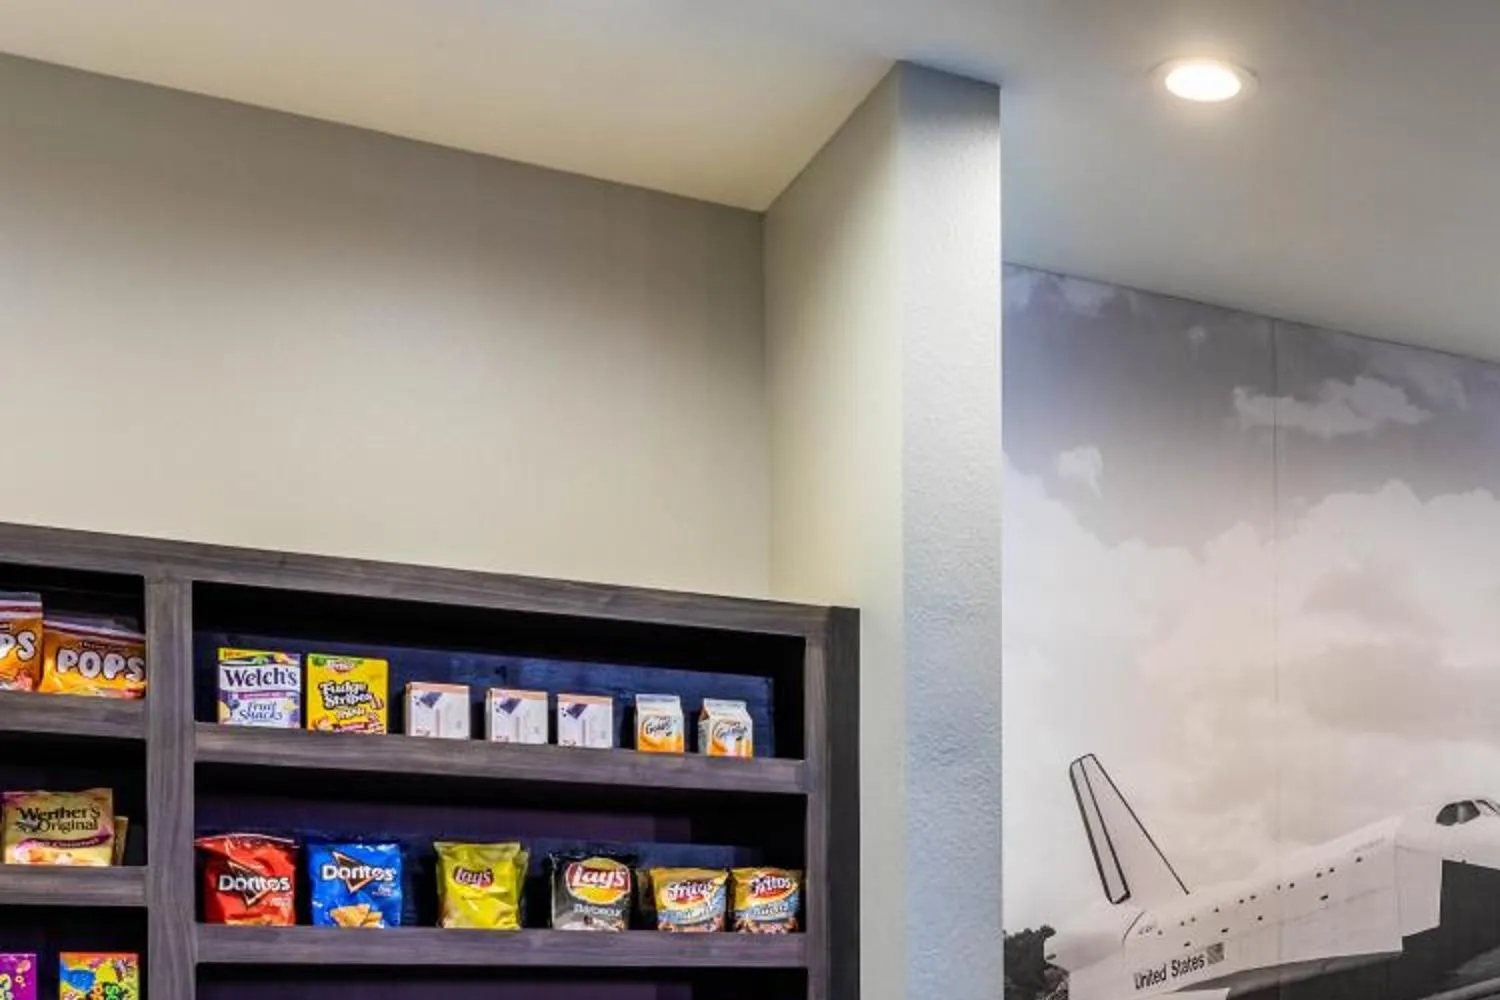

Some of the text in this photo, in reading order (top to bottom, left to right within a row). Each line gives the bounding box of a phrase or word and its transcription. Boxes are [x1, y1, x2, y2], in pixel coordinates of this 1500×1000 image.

[57, 648, 145, 681] POPS
[223, 667, 298, 687] Welch's
[319, 681, 367, 696] Fudge
[16, 805, 101, 821] Werther's
[40, 818, 99, 834] Original
[218, 873, 291, 891] Doritos
[322, 864, 397, 881] Doritos
[454, 866, 492, 887] Lay's
[575, 865, 626, 888] Lay's
[752, 875, 792, 896] Fritos
[1134, 953, 1205, 990] United States
